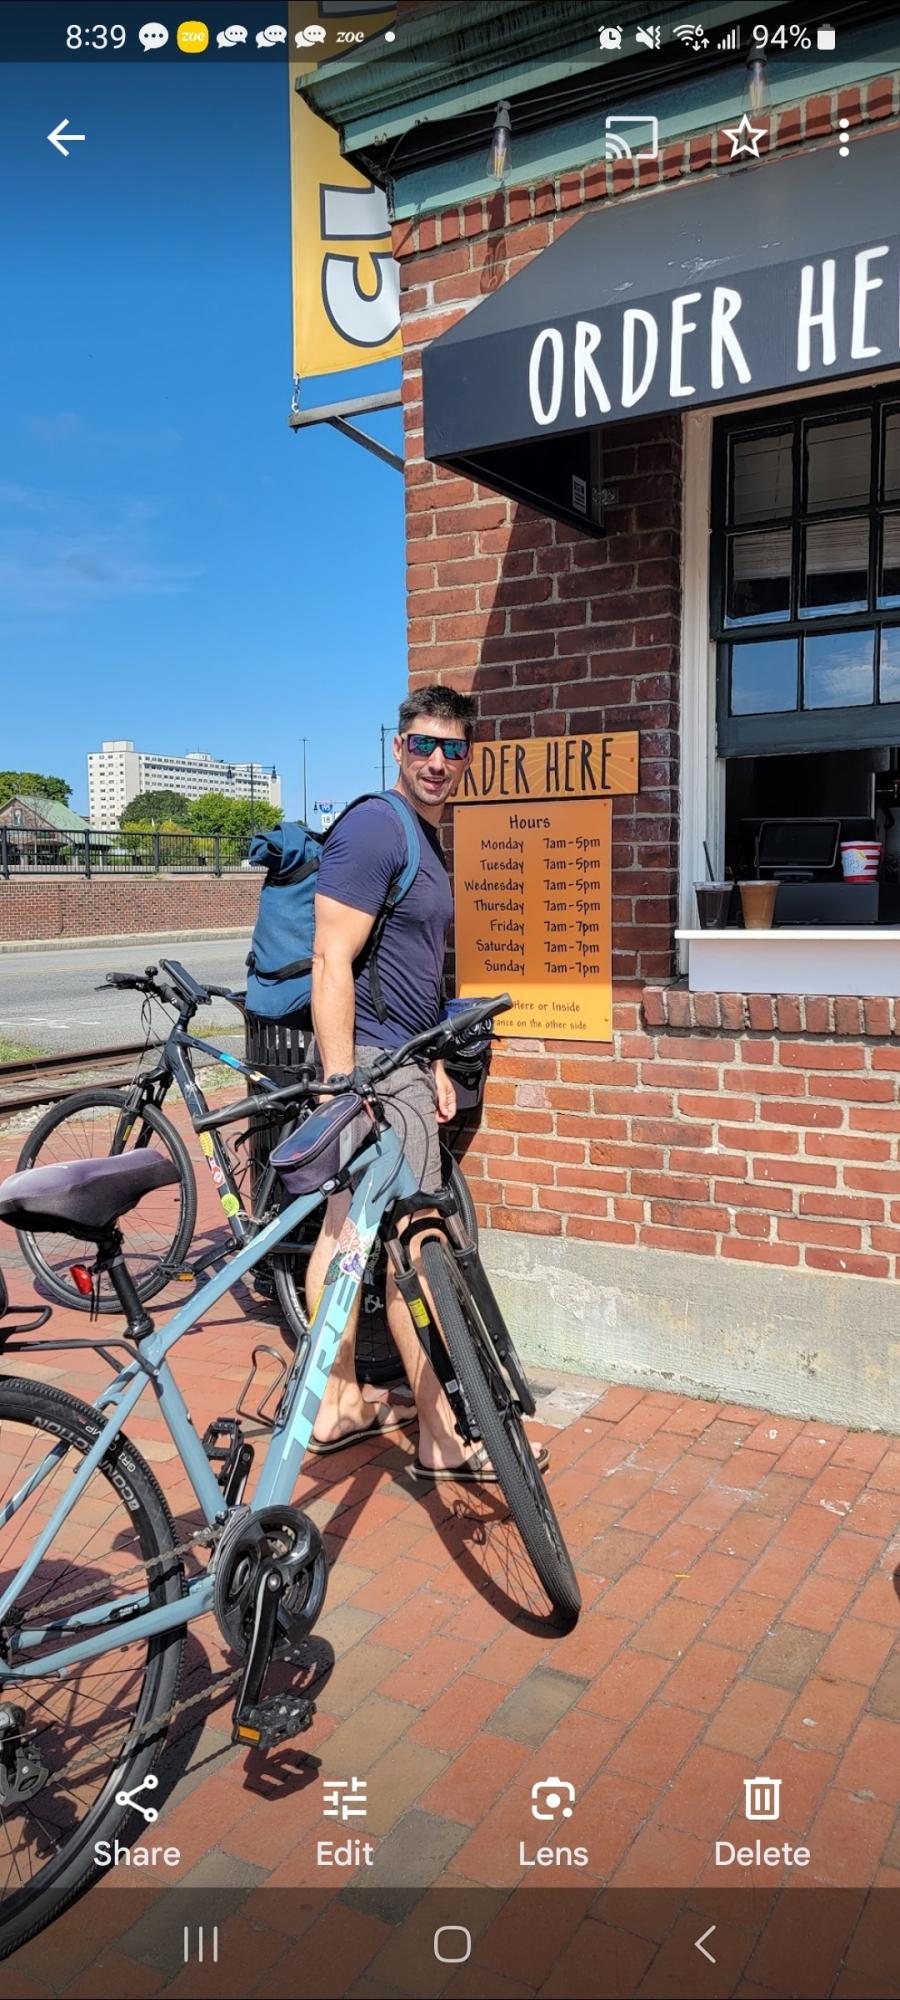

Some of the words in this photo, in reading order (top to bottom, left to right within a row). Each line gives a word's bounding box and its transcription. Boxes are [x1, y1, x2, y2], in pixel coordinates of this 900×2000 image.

[529, 286, 751, 425] ORDER
[797, 245, 900, 372] HE
[451, 744, 530, 797] RDER
[545, 737, 614, 793] HERE
[509, 814, 551, 830] Hours
[480, 837, 524, 854] Monday
[480, 858, 524, 874] Tuesday
[464, 878, 524, 895] Wednesday
[474, 898, 524, 915] Thursday
[490, 919, 524, 936] Friday
[475, 939, 524, 956] Saturday
[484, 959, 524, 976] Sunday
[538, 1003, 548, 1011] or
[552, 1001, 580, 1012] Inside
[530, 1018, 542, 1028] the
[545, 1020, 567, 1030] other
[570, 1022, 587, 1030] side
[85, 1425, 117, 1451] CMP
